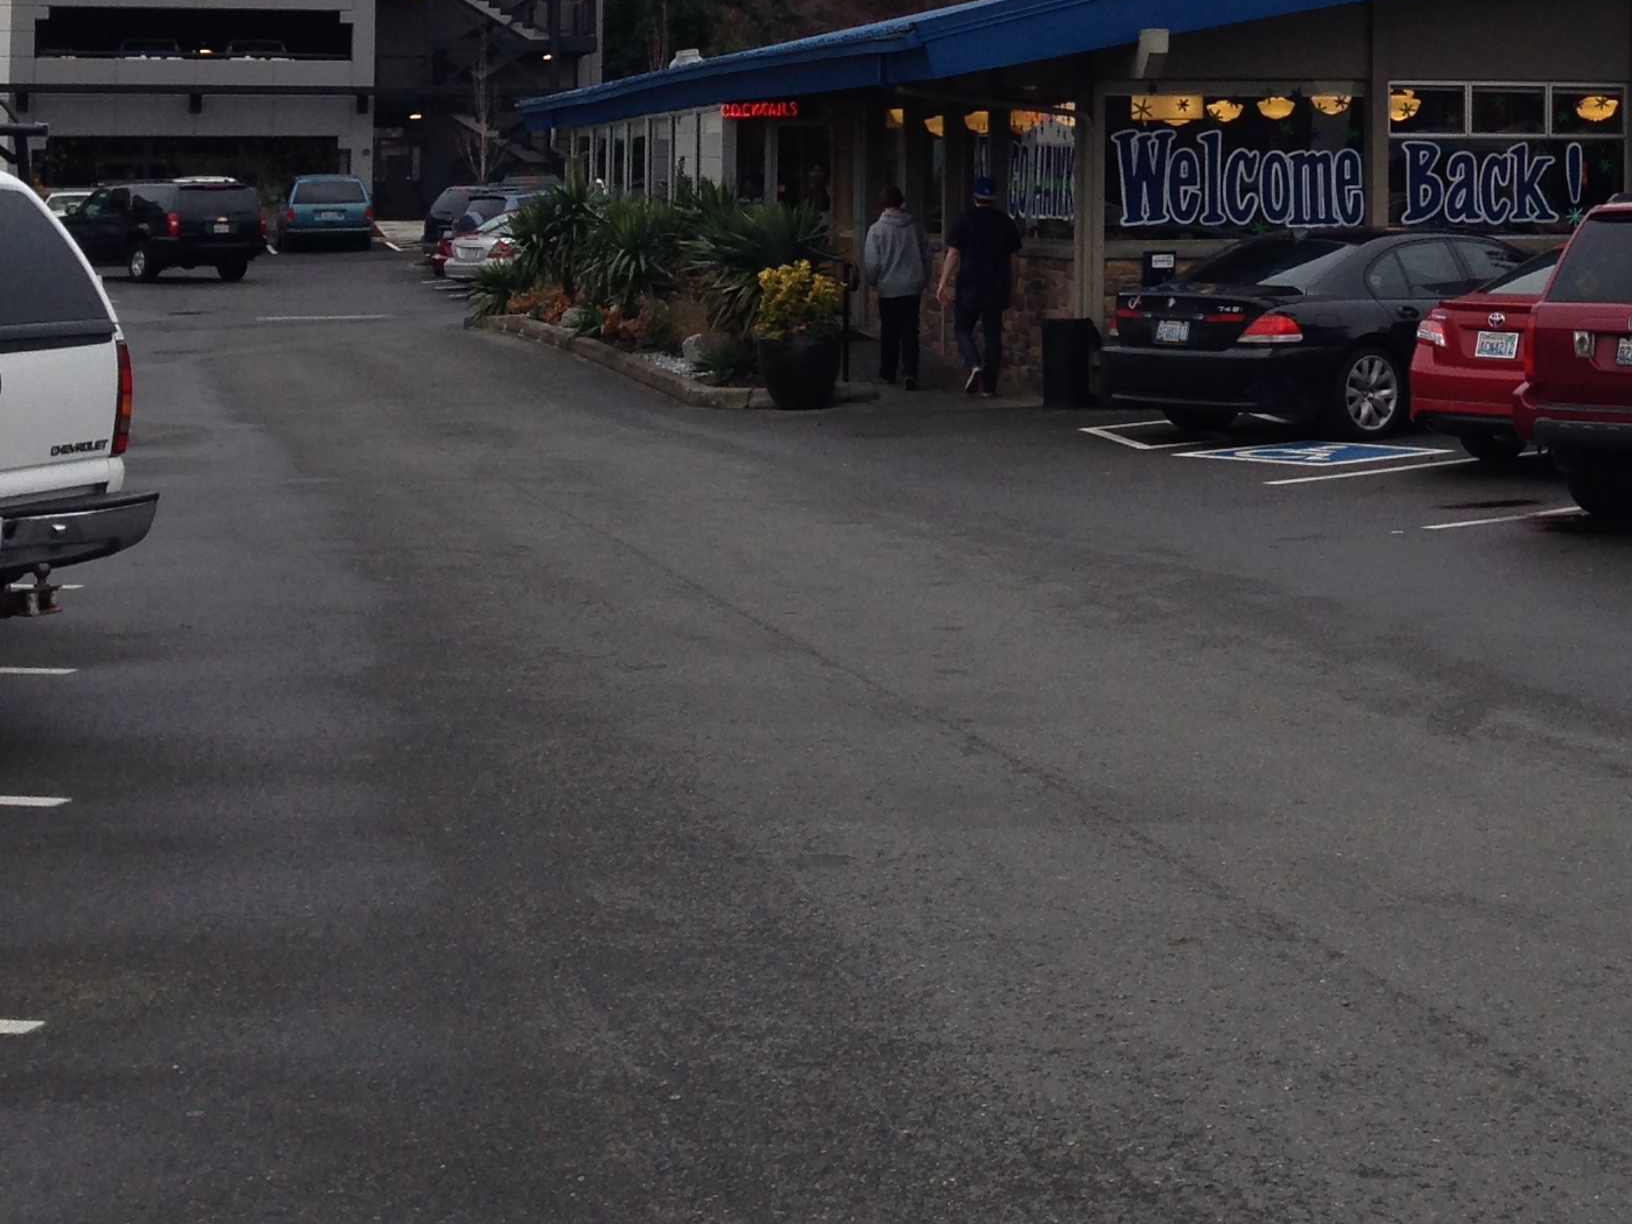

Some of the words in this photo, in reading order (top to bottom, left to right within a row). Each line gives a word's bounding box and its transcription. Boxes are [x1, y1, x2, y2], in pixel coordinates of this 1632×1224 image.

[721, 101, 798, 117] COCKTAILS
[1111, 129, 1365, 228] Welcome
[50, 439, 109, 456] CHEVROLET
